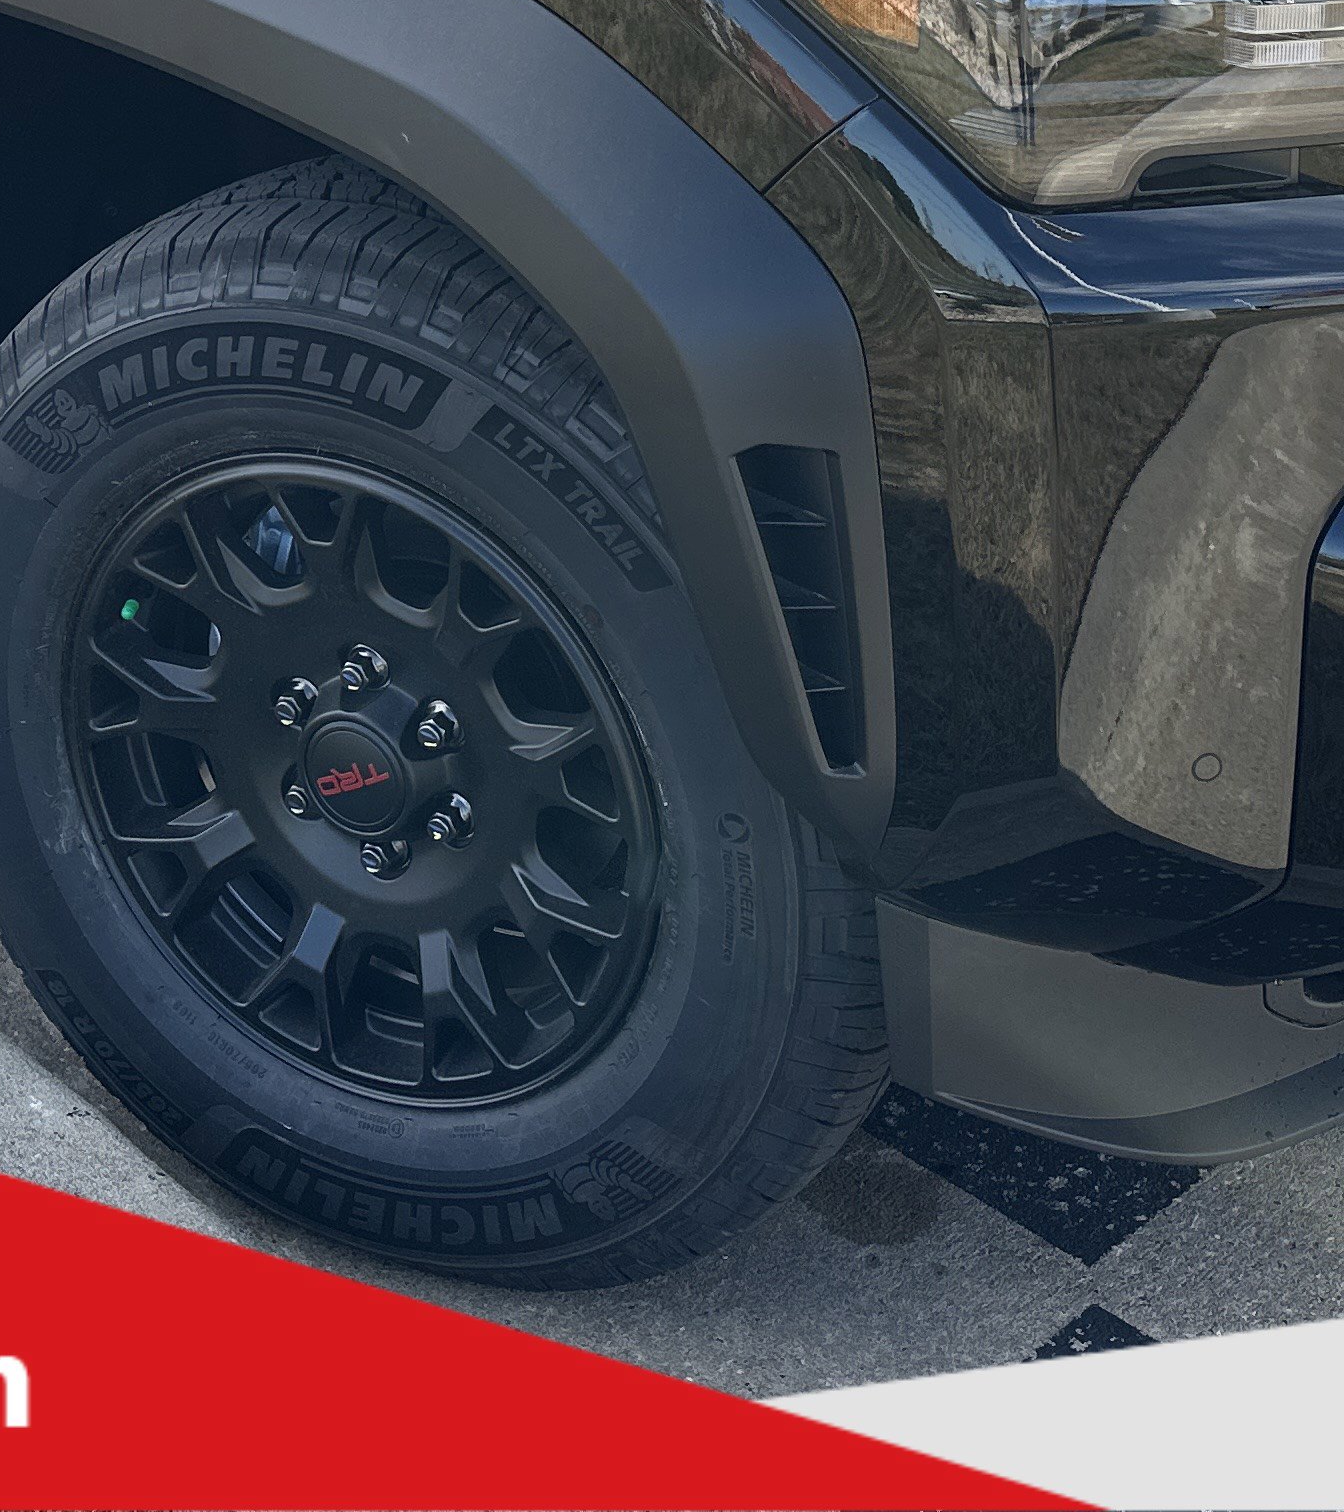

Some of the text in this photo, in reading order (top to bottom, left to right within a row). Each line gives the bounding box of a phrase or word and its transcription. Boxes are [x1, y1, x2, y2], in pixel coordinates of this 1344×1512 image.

[97, 334, 425, 414] MICHELIN
[493, 422, 645, 571] LTX TRAIL
[316, 763, 389, 796] TRD
[737, 851, 755, 937] MICHELIN
[235, 1144, 563, 1246] MICHELIN
